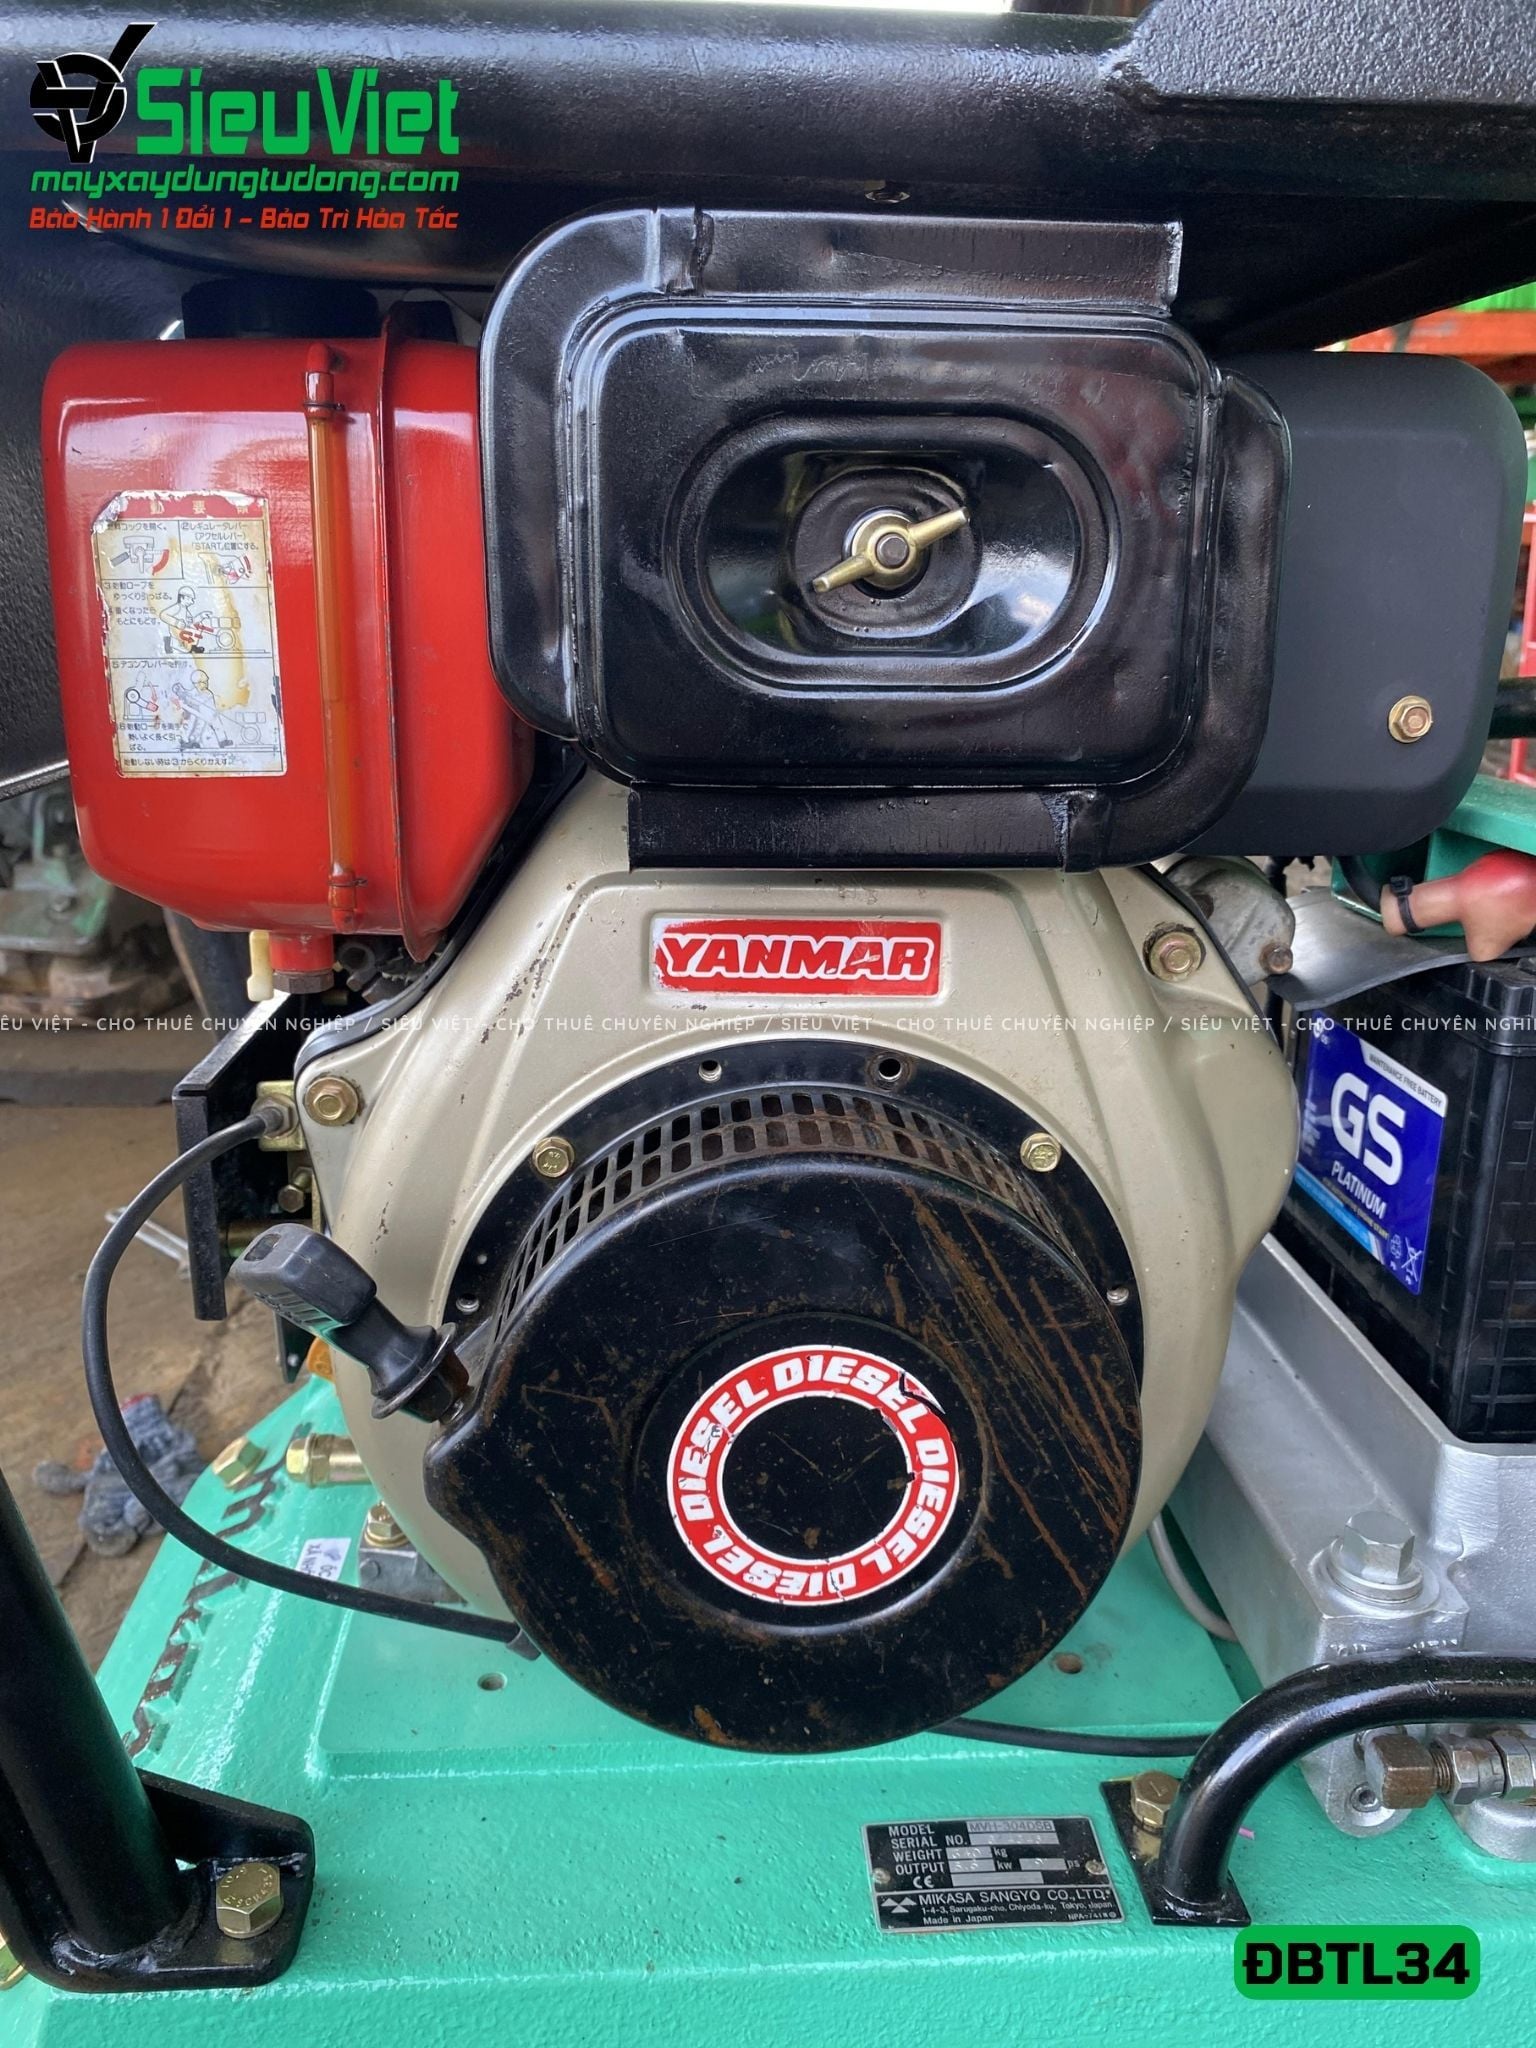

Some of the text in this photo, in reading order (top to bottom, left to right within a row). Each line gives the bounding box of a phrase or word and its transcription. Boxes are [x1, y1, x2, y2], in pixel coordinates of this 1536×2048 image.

[659, 934, 934, 980] YANMAR
[1417, 1085, 1442, 1108] BATTERY
[1331, 1072, 1406, 1186] GS
[1331, 1160, 1387, 1220] PLATINUM
[677, 1354, 950, 1597] DIESEL DIESEL DIESEL DIESEL
[888, 1824, 935, 1837] MODEL
[891, 1835, 968, 1849] SERIAL NO.
[892, 1849, 943, 1863] WEIGHT
[993, 1847, 1007, 1858] kg
[895, 1862, 945, 1876] OUTPUT
[919, 1892, 975, 1905] MIKASA
[980, 1890, 1041, 1903] SANGYO
[923, 1914, 994, 1925] Made in Japan
